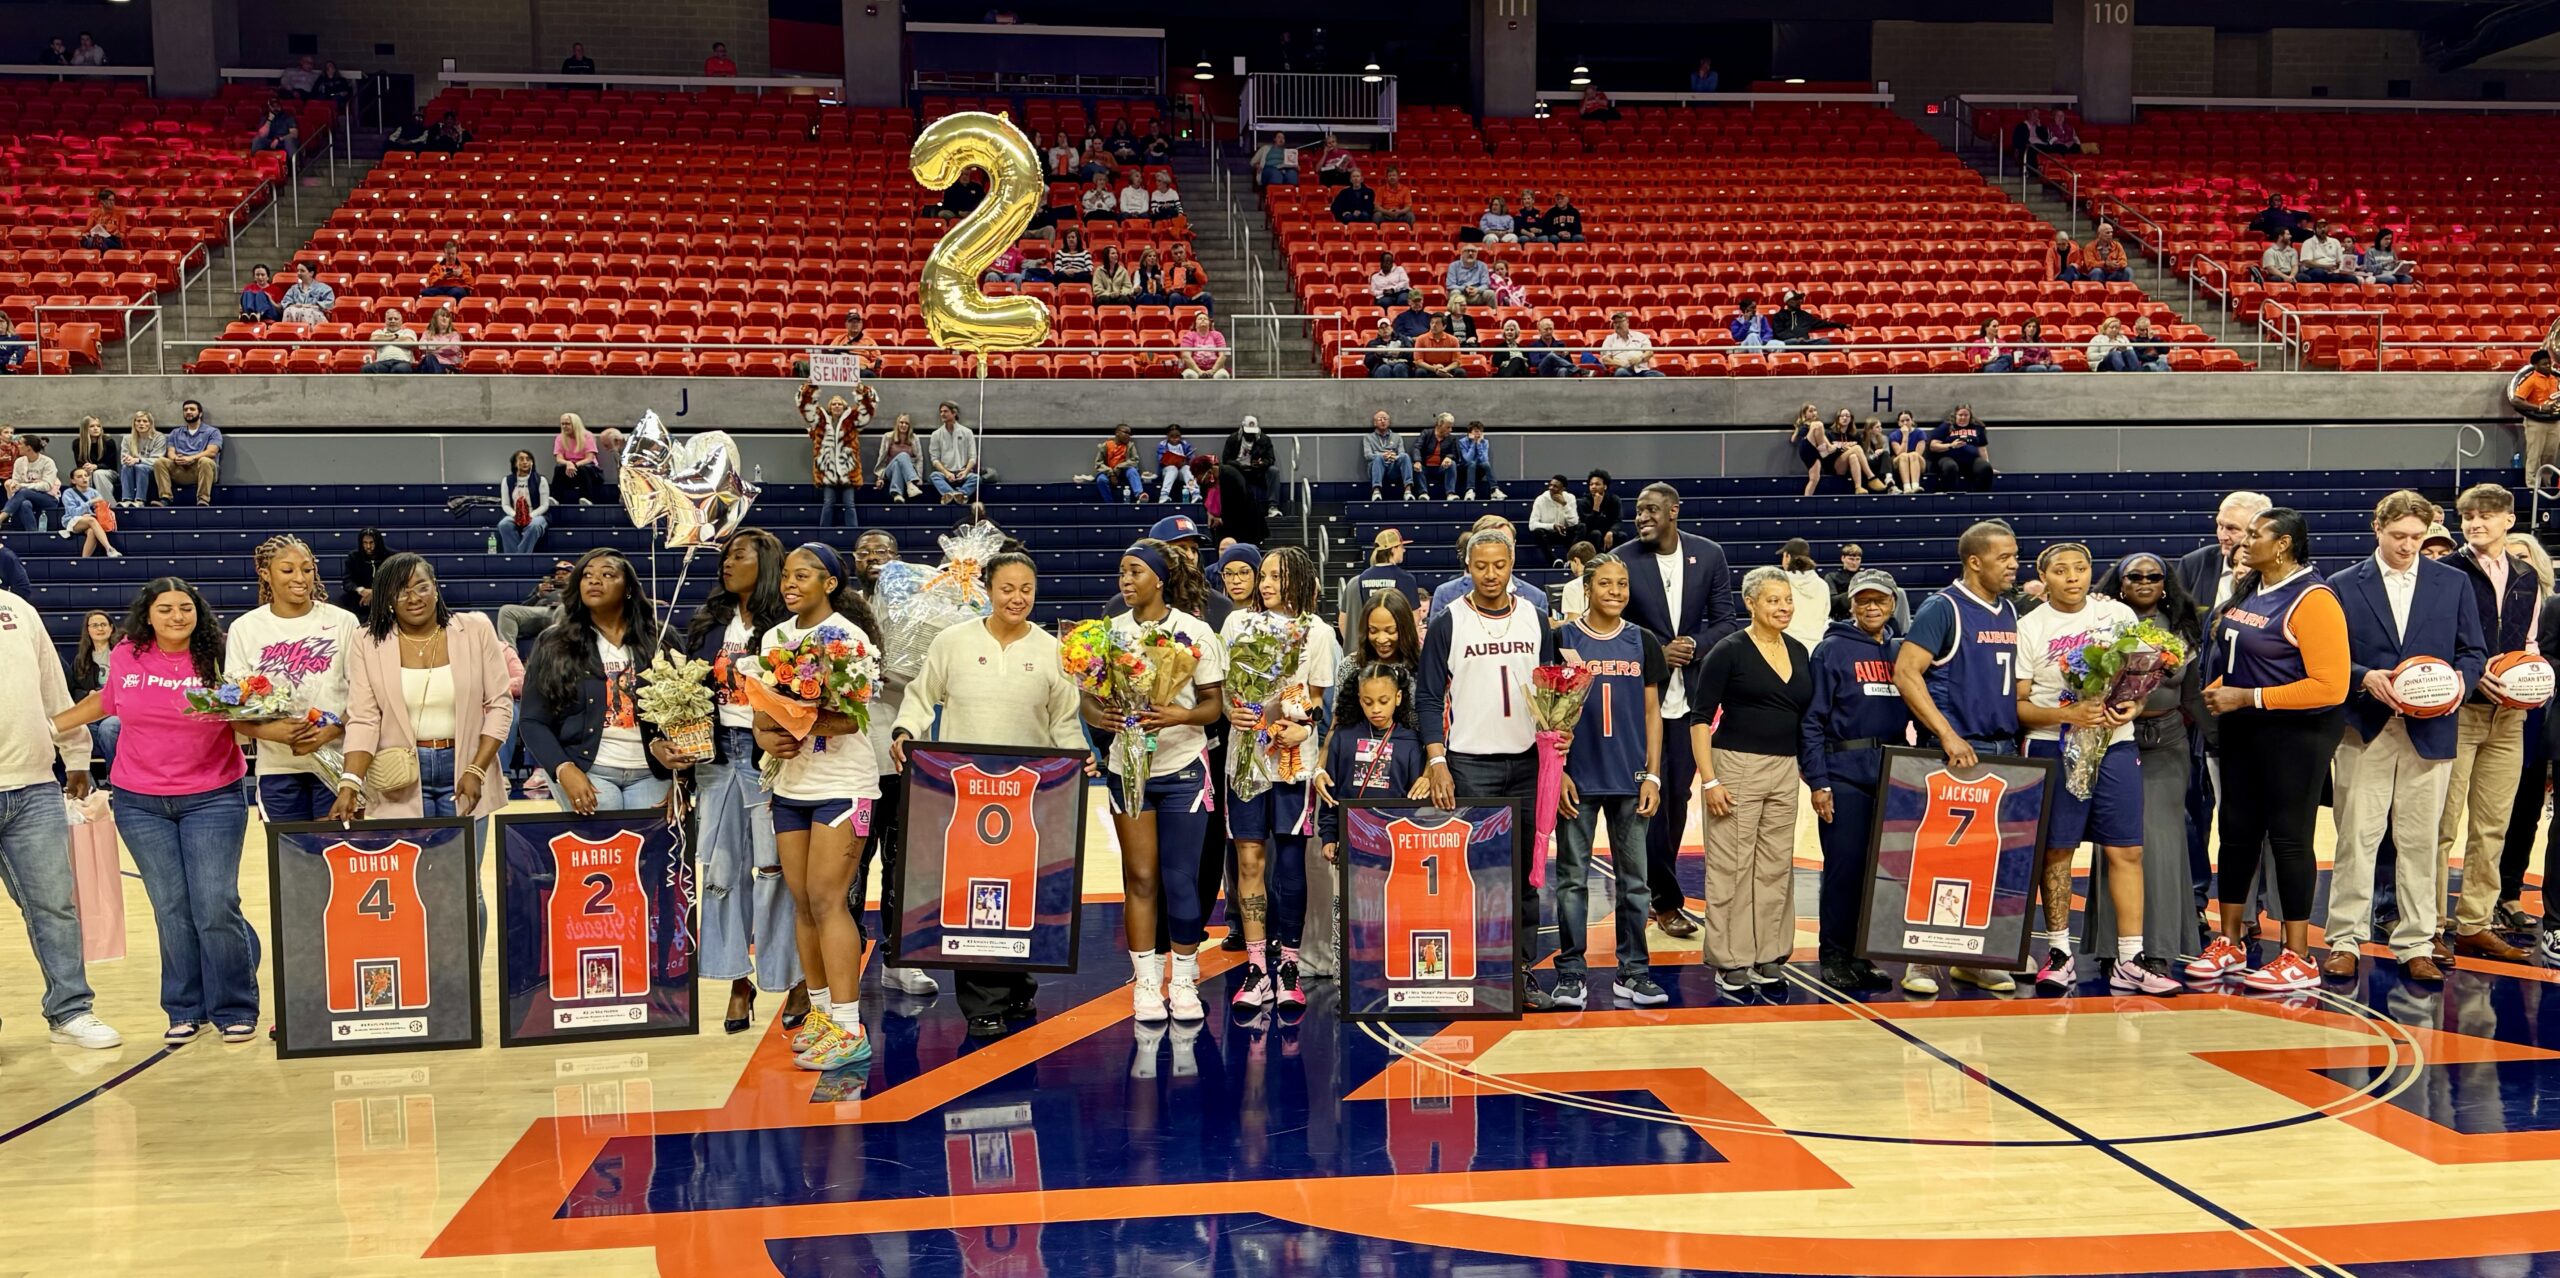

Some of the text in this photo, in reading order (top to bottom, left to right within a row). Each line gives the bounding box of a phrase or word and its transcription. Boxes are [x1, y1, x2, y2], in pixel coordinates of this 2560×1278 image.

[2094, 3, 2129, 25] 110
[813, 365, 860, 383] SENIORS
[676, 388, 689, 417] J
[1873, 385, 1893, 413] H
[1463, 641, 1535, 660] AUBURN
[2224, 627, 2240, 675] 7
[1995, 652, 2011, 697] 7
[1499, 665, 1512, 718] 1
[1602, 682, 1614, 738] 1
[968, 779, 1021, 797] BELLOSO
[1938, 784, 1991, 804] JACKSON
[975, 802, 1013, 846] 0
[1945, 806, 1977, 847] 7
[1398, 832, 1461, 849] PETTICORD
[349, 854, 400, 874] DUHON
[571, 848, 623, 868] HARRIS
[1420, 854, 1440, 896] 1
[356, 877, 397, 922] 4
[581, 872, 616, 915] 2
